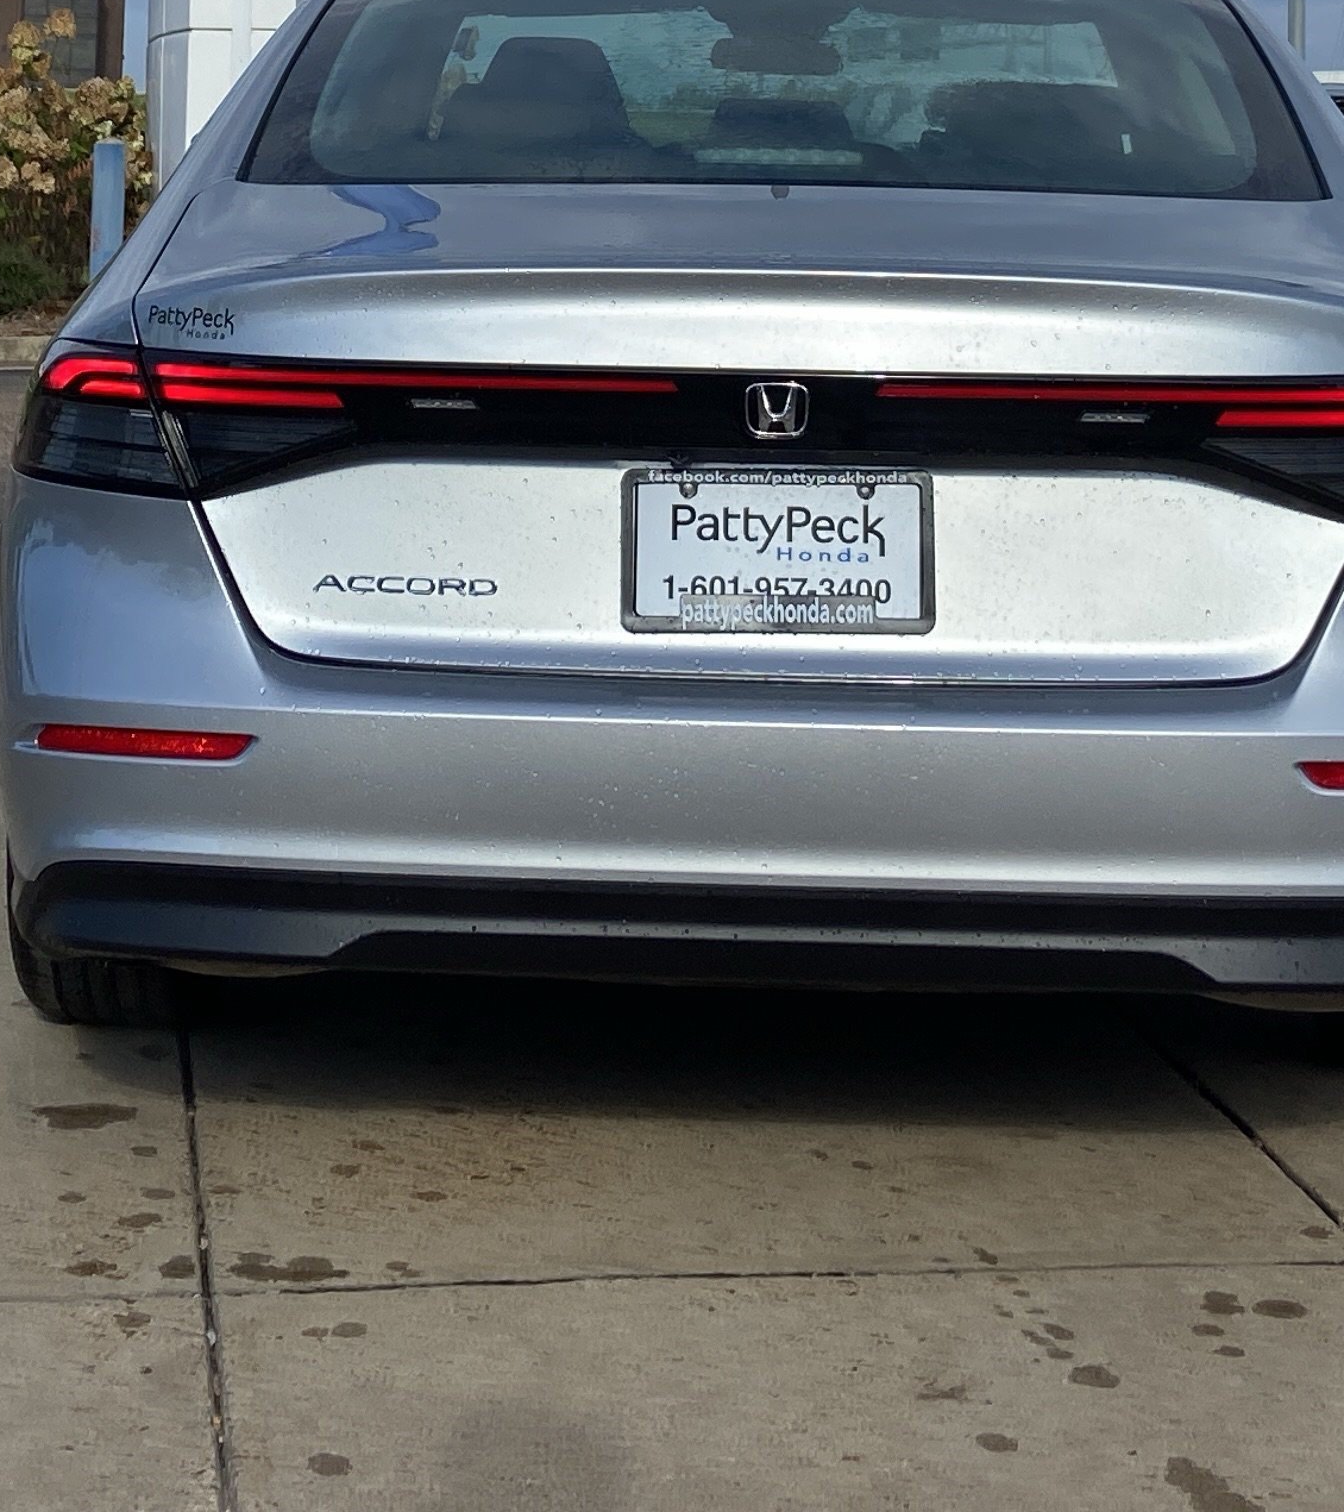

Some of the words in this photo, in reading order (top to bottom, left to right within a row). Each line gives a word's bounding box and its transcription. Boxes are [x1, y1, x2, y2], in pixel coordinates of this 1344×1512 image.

[148, 304, 235, 335] PattyPeck
[186, 328, 226, 340] Honda
[647, 470, 907, 488] facebook.com/pattypeckhonda
[671, 503, 886, 558] PattyPeck
[776, 546, 870, 564] Honda
[312, 574, 498, 597] ACCORD
[662, 574, 892, 604] 1-601-957-3400
[680, 593, 874, 631] pattypeckhonda.com
